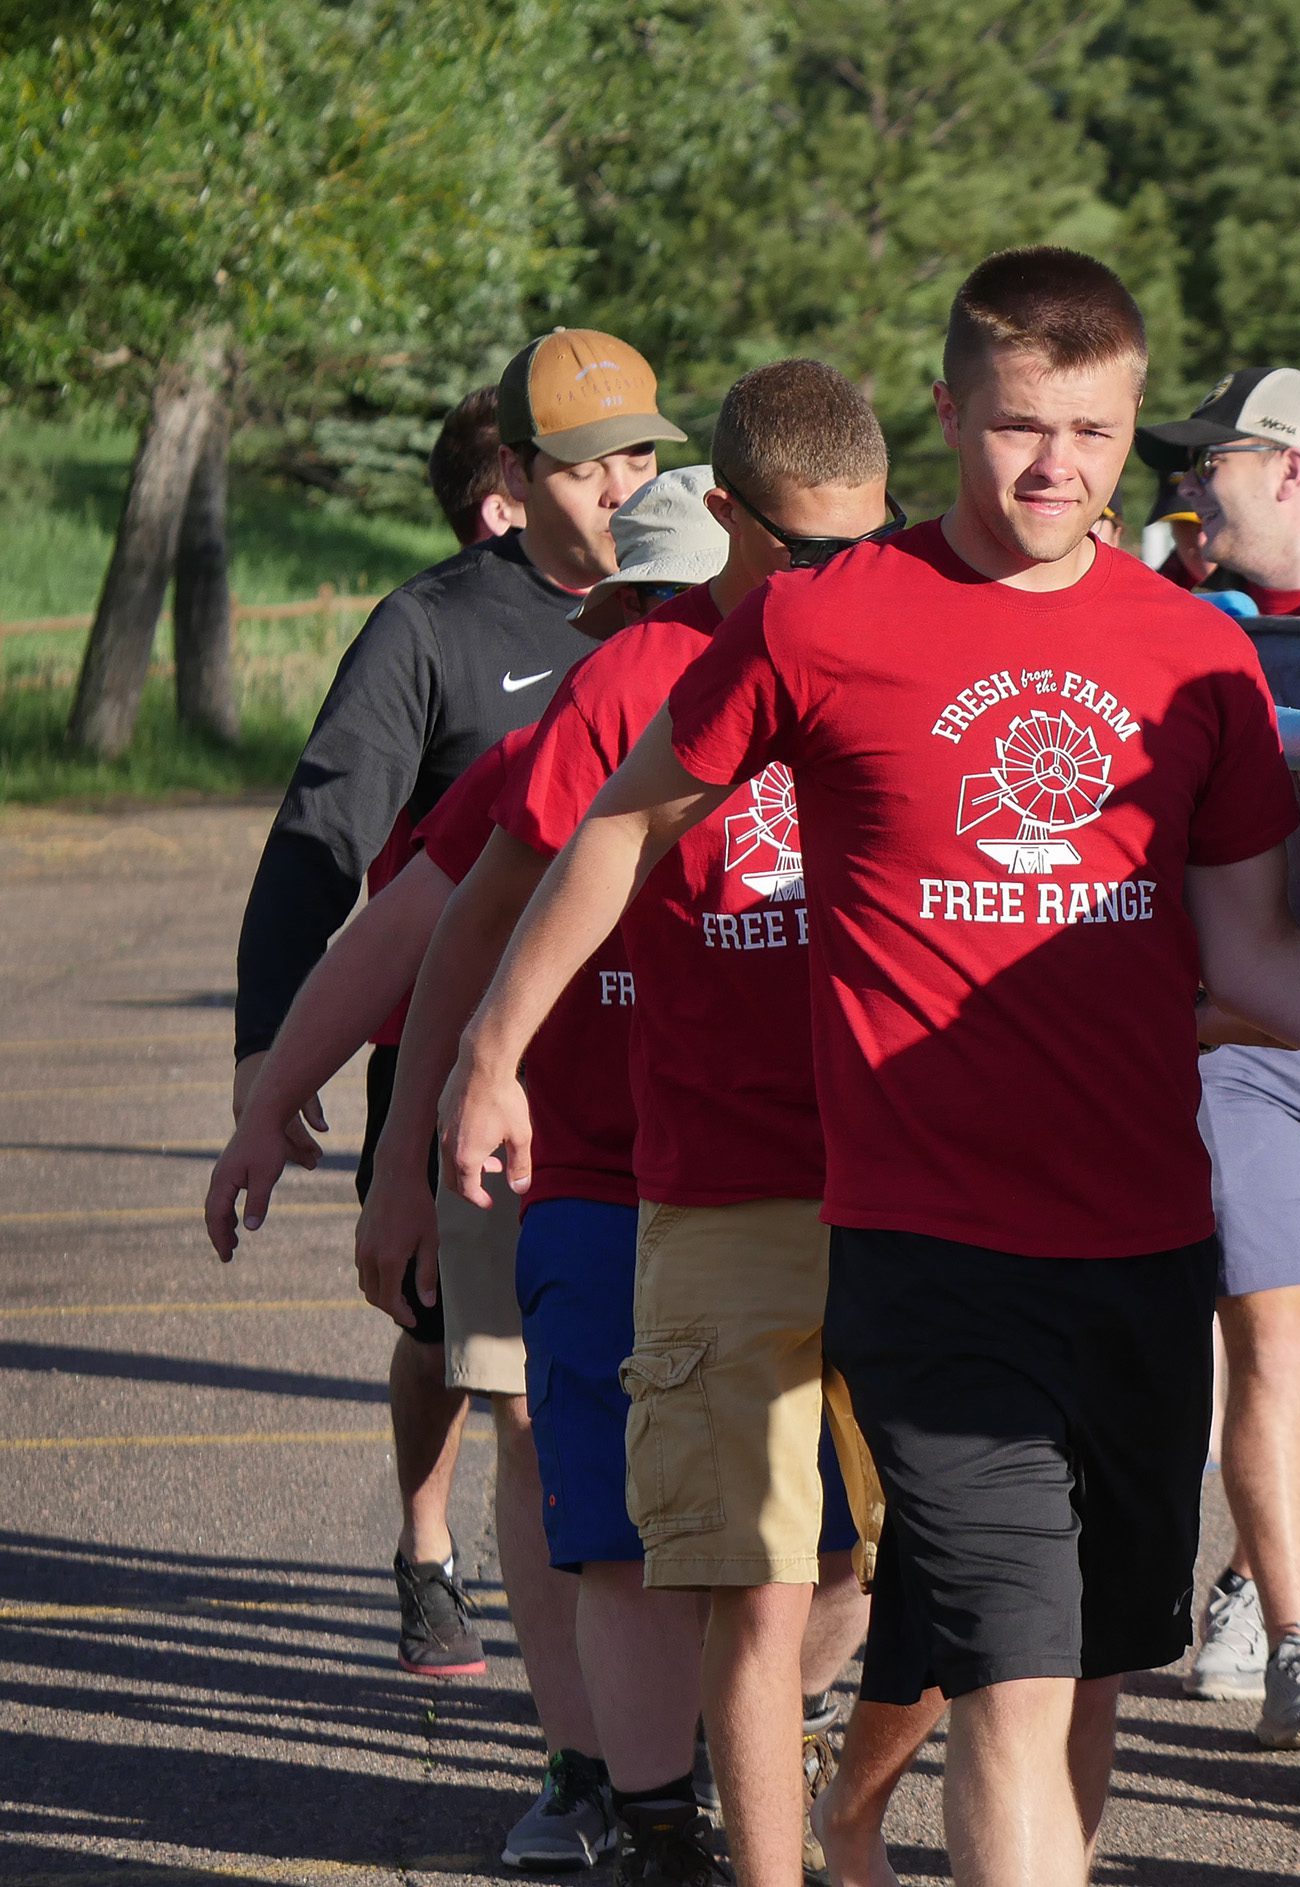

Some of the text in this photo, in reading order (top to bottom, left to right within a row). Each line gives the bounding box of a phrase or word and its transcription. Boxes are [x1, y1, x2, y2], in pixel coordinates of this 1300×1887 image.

[931, 668, 1142, 745] FRESH from the FARM
[919, 878, 1157, 924] FREE RANGE
[702, 910, 787, 950] FREE
[599, 971, 636, 1006] FR
